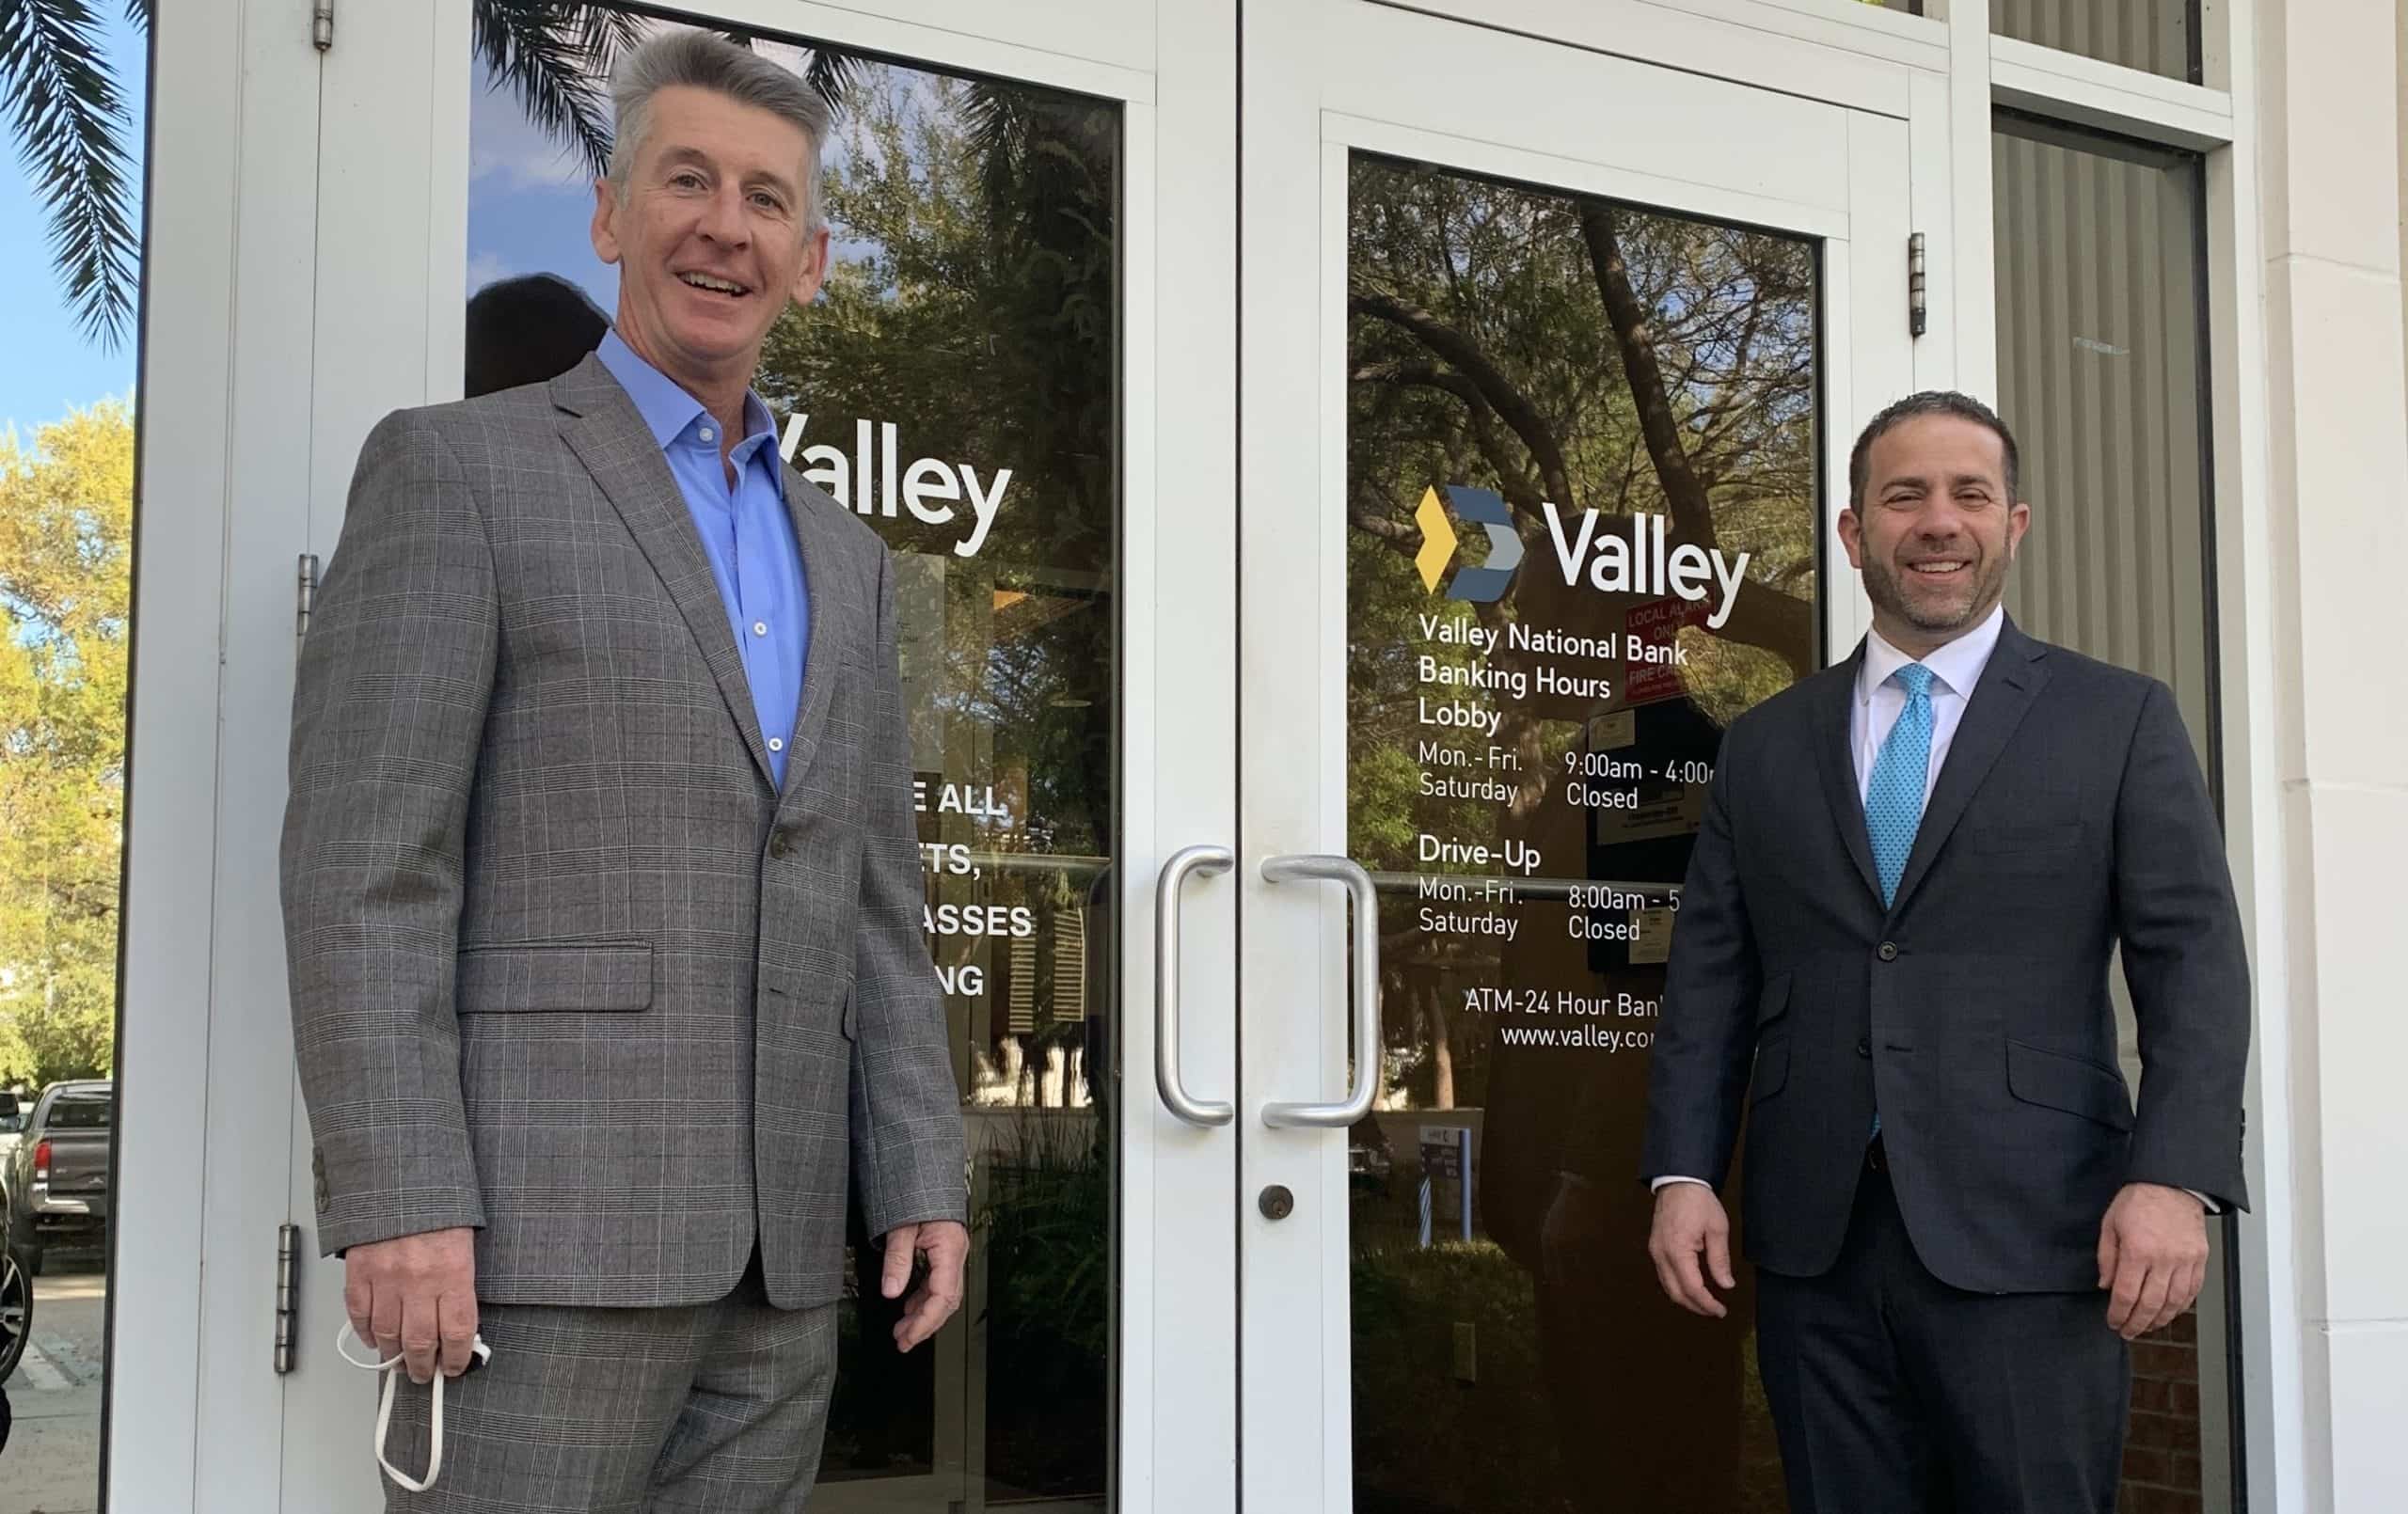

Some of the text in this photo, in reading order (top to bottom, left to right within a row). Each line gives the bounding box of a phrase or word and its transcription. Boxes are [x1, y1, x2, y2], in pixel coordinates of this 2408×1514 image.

[780, 413, 1013, 558] alley
[1542, 502, 1751, 629] Valley
[1418, 613, 1688, 666] Valley National Bank
[1419, 655, 1611, 700] Banking Hours
[1419, 697, 1502, 737] Lobby
[1564, 751, 1642, 780] 9:00am
[1665, 759, 1714, 784] 4:00
[938, 783, 1007, 816] ALL
[1419, 772, 1638, 810] Saturday Closed
[918, 842, 980, 880] TS,
[1419, 834, 1541, 875] Drive-Up
[1569, 885, 1645, 910] 8:00am
[1419, 907, 1518, 940] Saturday
[1569, 915, 1640, 941] Closed
[1465, 987, 1663, 1017] ATM-24 Hour Ban
[1501, 1023, 1655, 1053] www.valley.co
